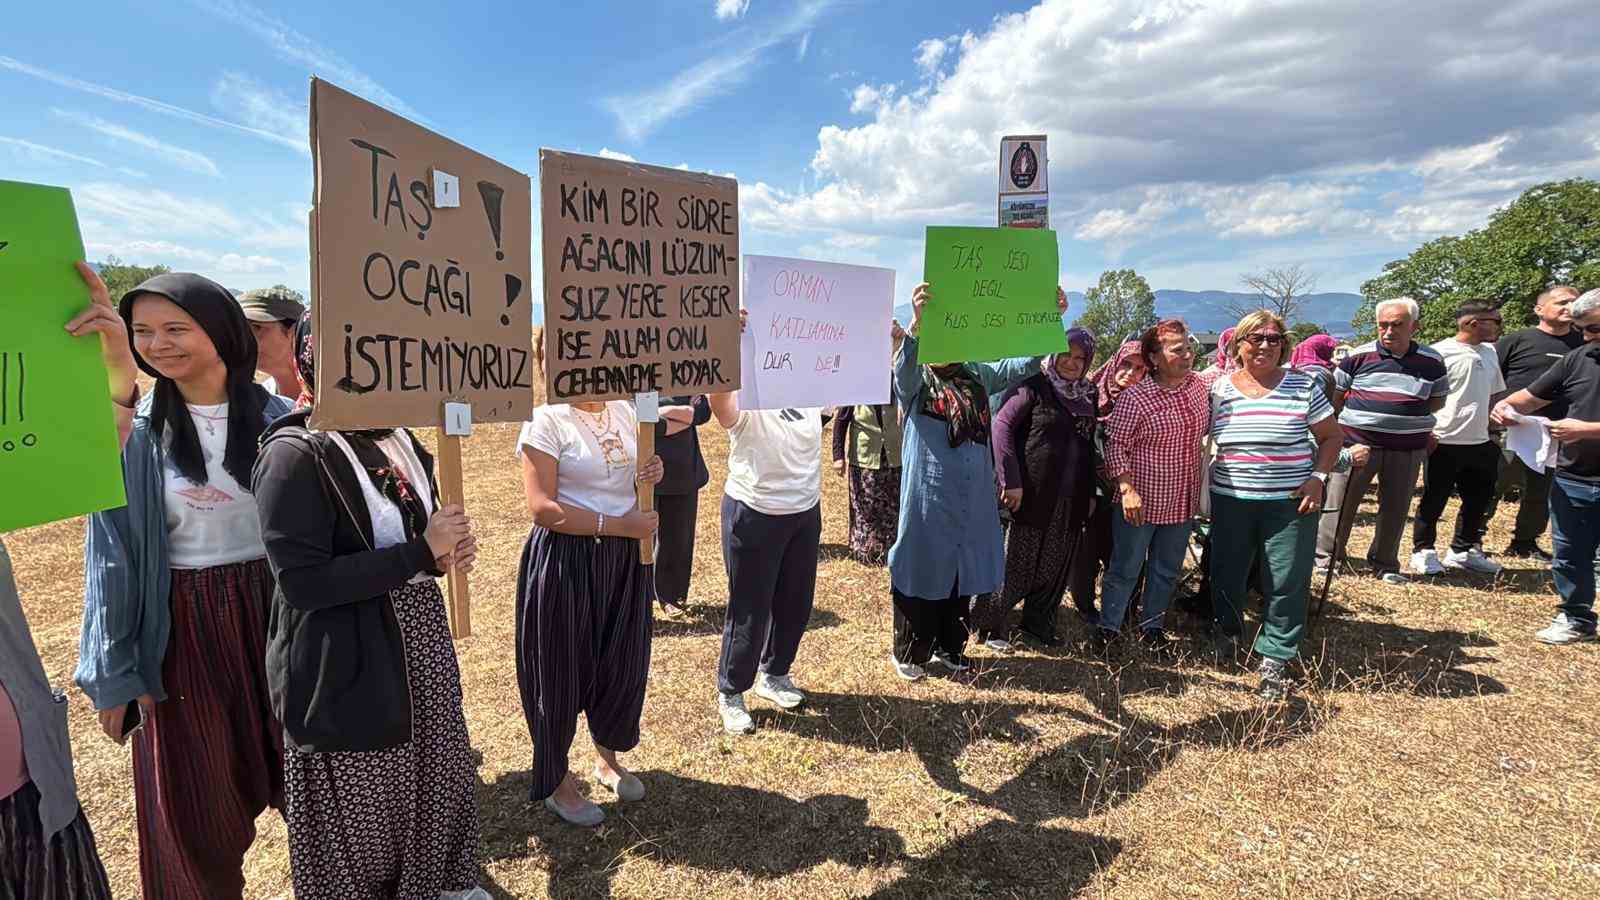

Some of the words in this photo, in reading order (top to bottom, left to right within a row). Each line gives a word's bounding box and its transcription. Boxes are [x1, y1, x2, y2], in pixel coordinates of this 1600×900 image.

[349, 138, 432, 240] TAŞ
[560, 180, 608, 224] KİM
[621, 187, 663, 227] BİR
[676, 195, 735, 235] SİDRE
[560, 233, 652, 276] AĞACINI
[662, 237, 736, 275] LÜZUM-
[951, 244, 984, 272] TAŞ
[363, 252, 471, 317] OCAĞI
[560, 285, 611, 321] SUZ
[616, 283, 668, 318] YERE
[680, 284, 732, 318] KESER
[774, 269, 836, 303] ORMAN
[335, 323, 531, 394] İSTEMİYORUZ
[600, 325, 660, 359] ALLAH
[666, 324, 708, 351] ONU
[763, 351, 793, 371] DUR
[554, 362, 663, 398] CEHENNEME
[671, 358, 731, 387] KOYAR.
